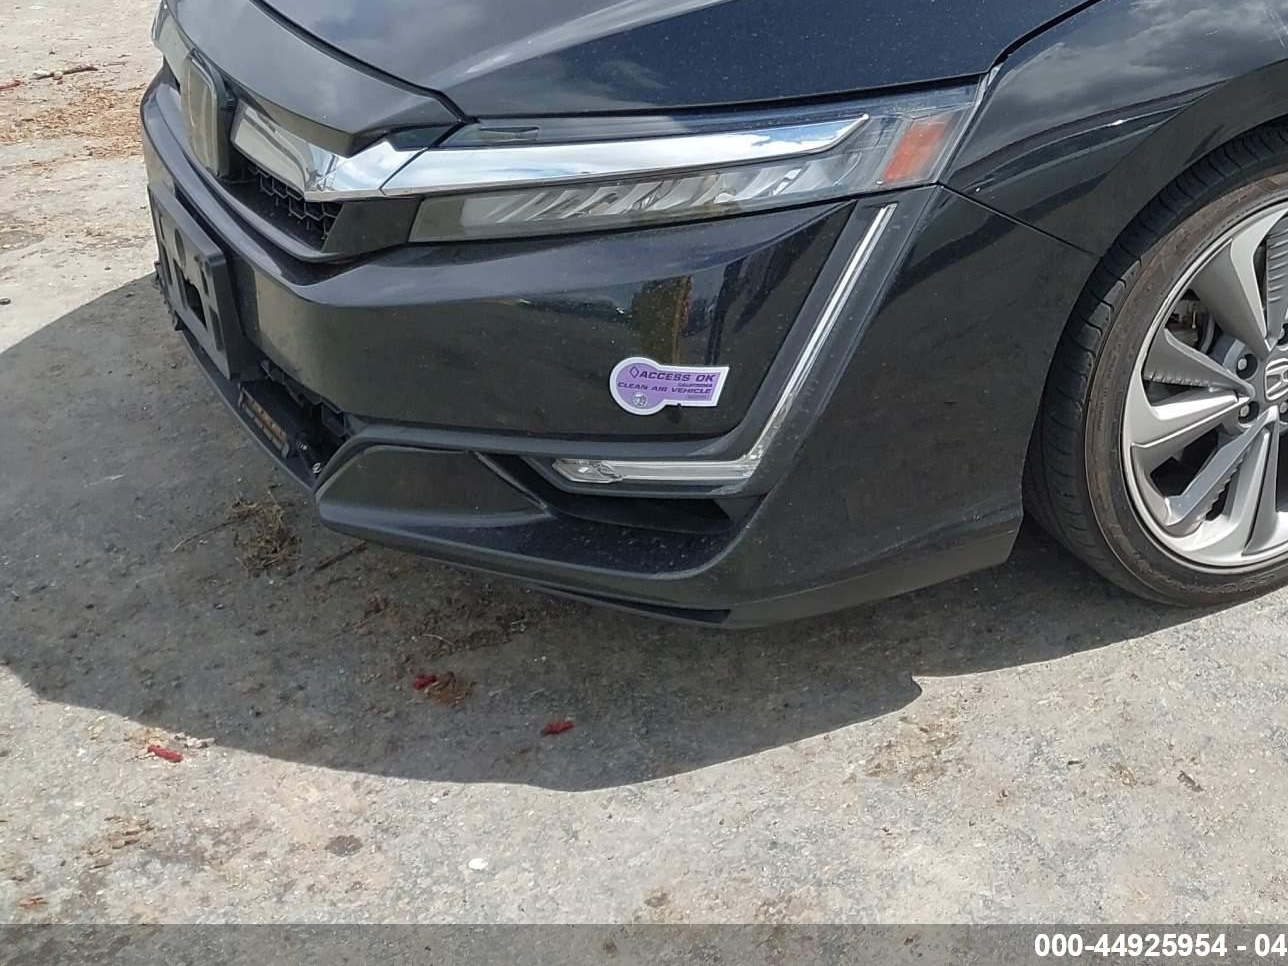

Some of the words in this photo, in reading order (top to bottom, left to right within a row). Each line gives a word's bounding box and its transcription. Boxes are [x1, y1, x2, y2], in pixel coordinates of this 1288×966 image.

[639, 370, 691, 382] ACCESS
[696, 374, 716, 382] OK
[617, 382, 649, 391] CLEAN
